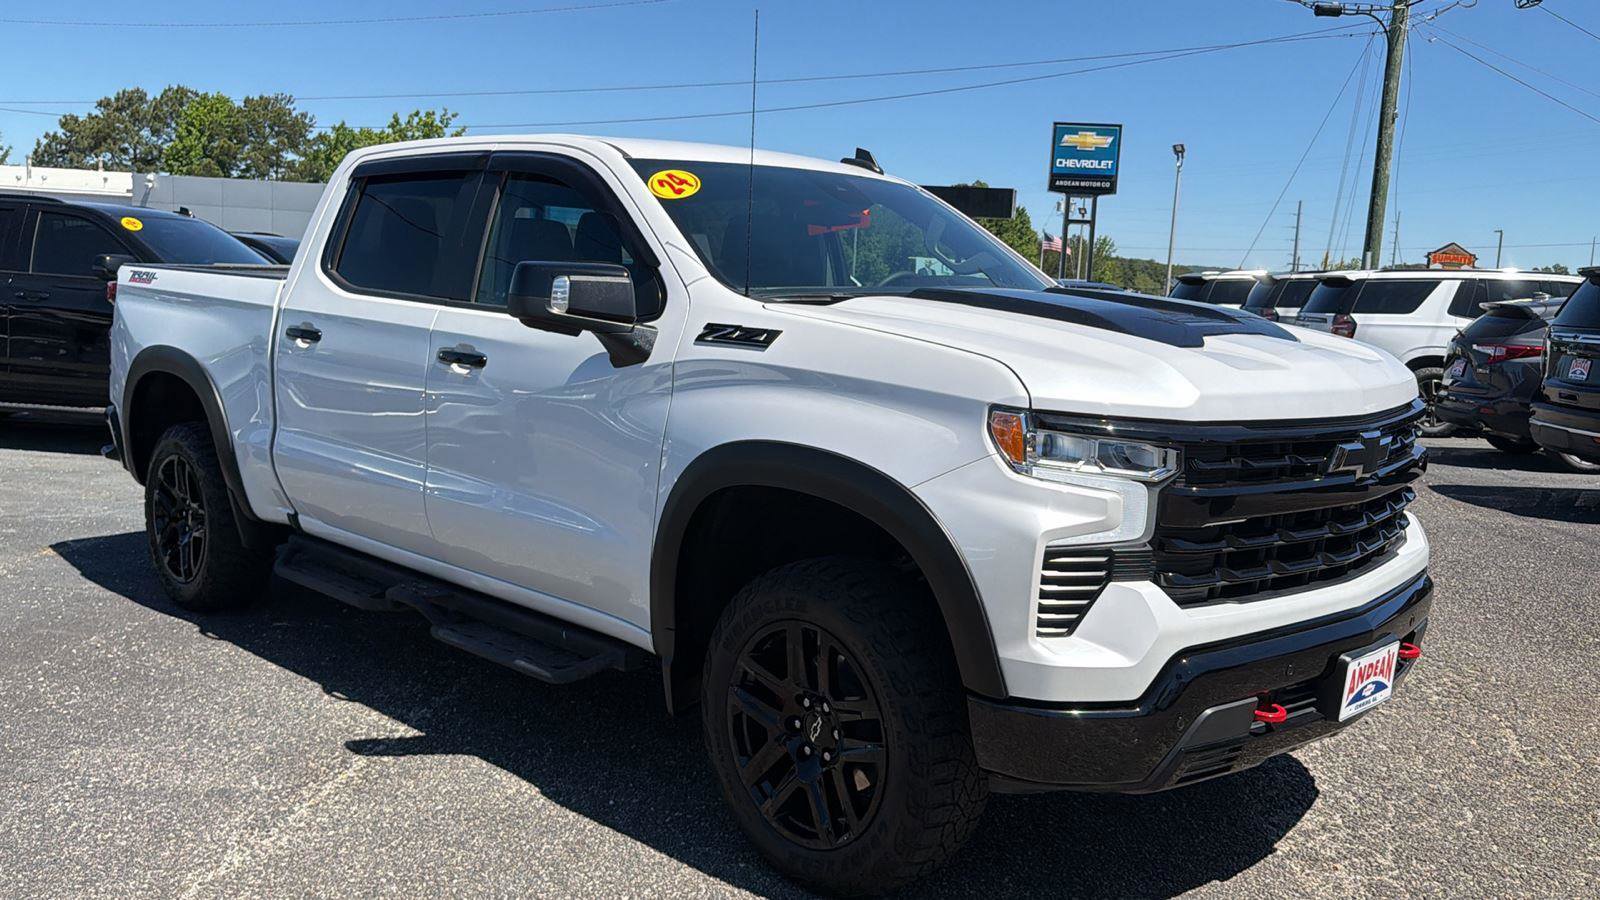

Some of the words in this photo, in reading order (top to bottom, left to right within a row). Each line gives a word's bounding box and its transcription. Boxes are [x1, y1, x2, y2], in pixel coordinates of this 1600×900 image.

[1056, 158, 1113, 169] CHEVROLET
[657, 173, 694, 195] 24
[129, 270, 158, 281] TRAIL
[693, 322, 783, 352] Z71
[1346, 652, 1395, 700] ANDEAN
